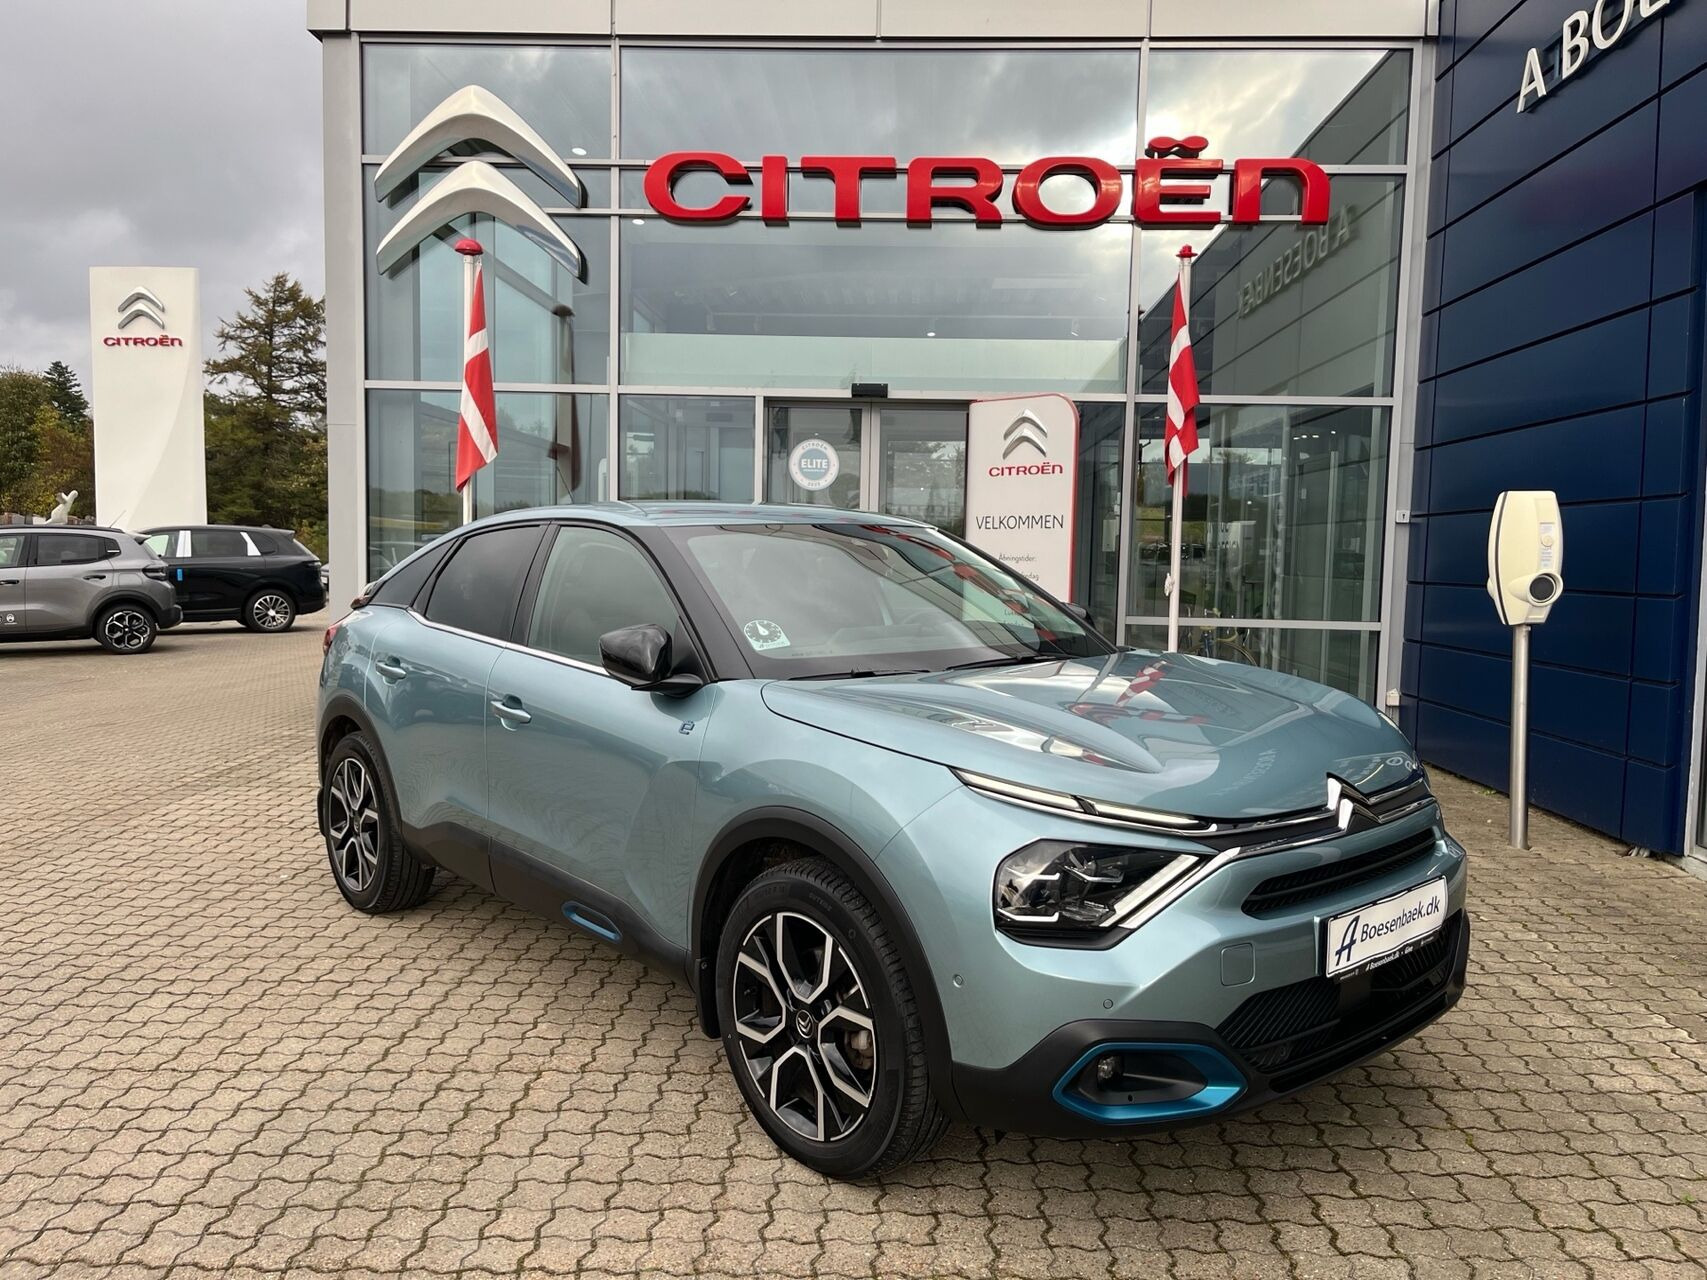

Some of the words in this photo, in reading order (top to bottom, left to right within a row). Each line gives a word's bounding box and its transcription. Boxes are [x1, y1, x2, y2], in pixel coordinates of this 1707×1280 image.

[1516, 47, 1547, 113] A
[1562, 0, 1670, 80] BO
[644, 136, 1331, 228] CITROËN
[103, 334, 183, 347] CITROËN
[801, 458, 828, 469] ELITE
[988, 461, 1064, 477] CITROËN
[975, 514, 1064, 530] VELKOMMEN
[1335, 914, 1361, 966] A
[1360, 895, 1441, 943] Boesenbaek.dk
